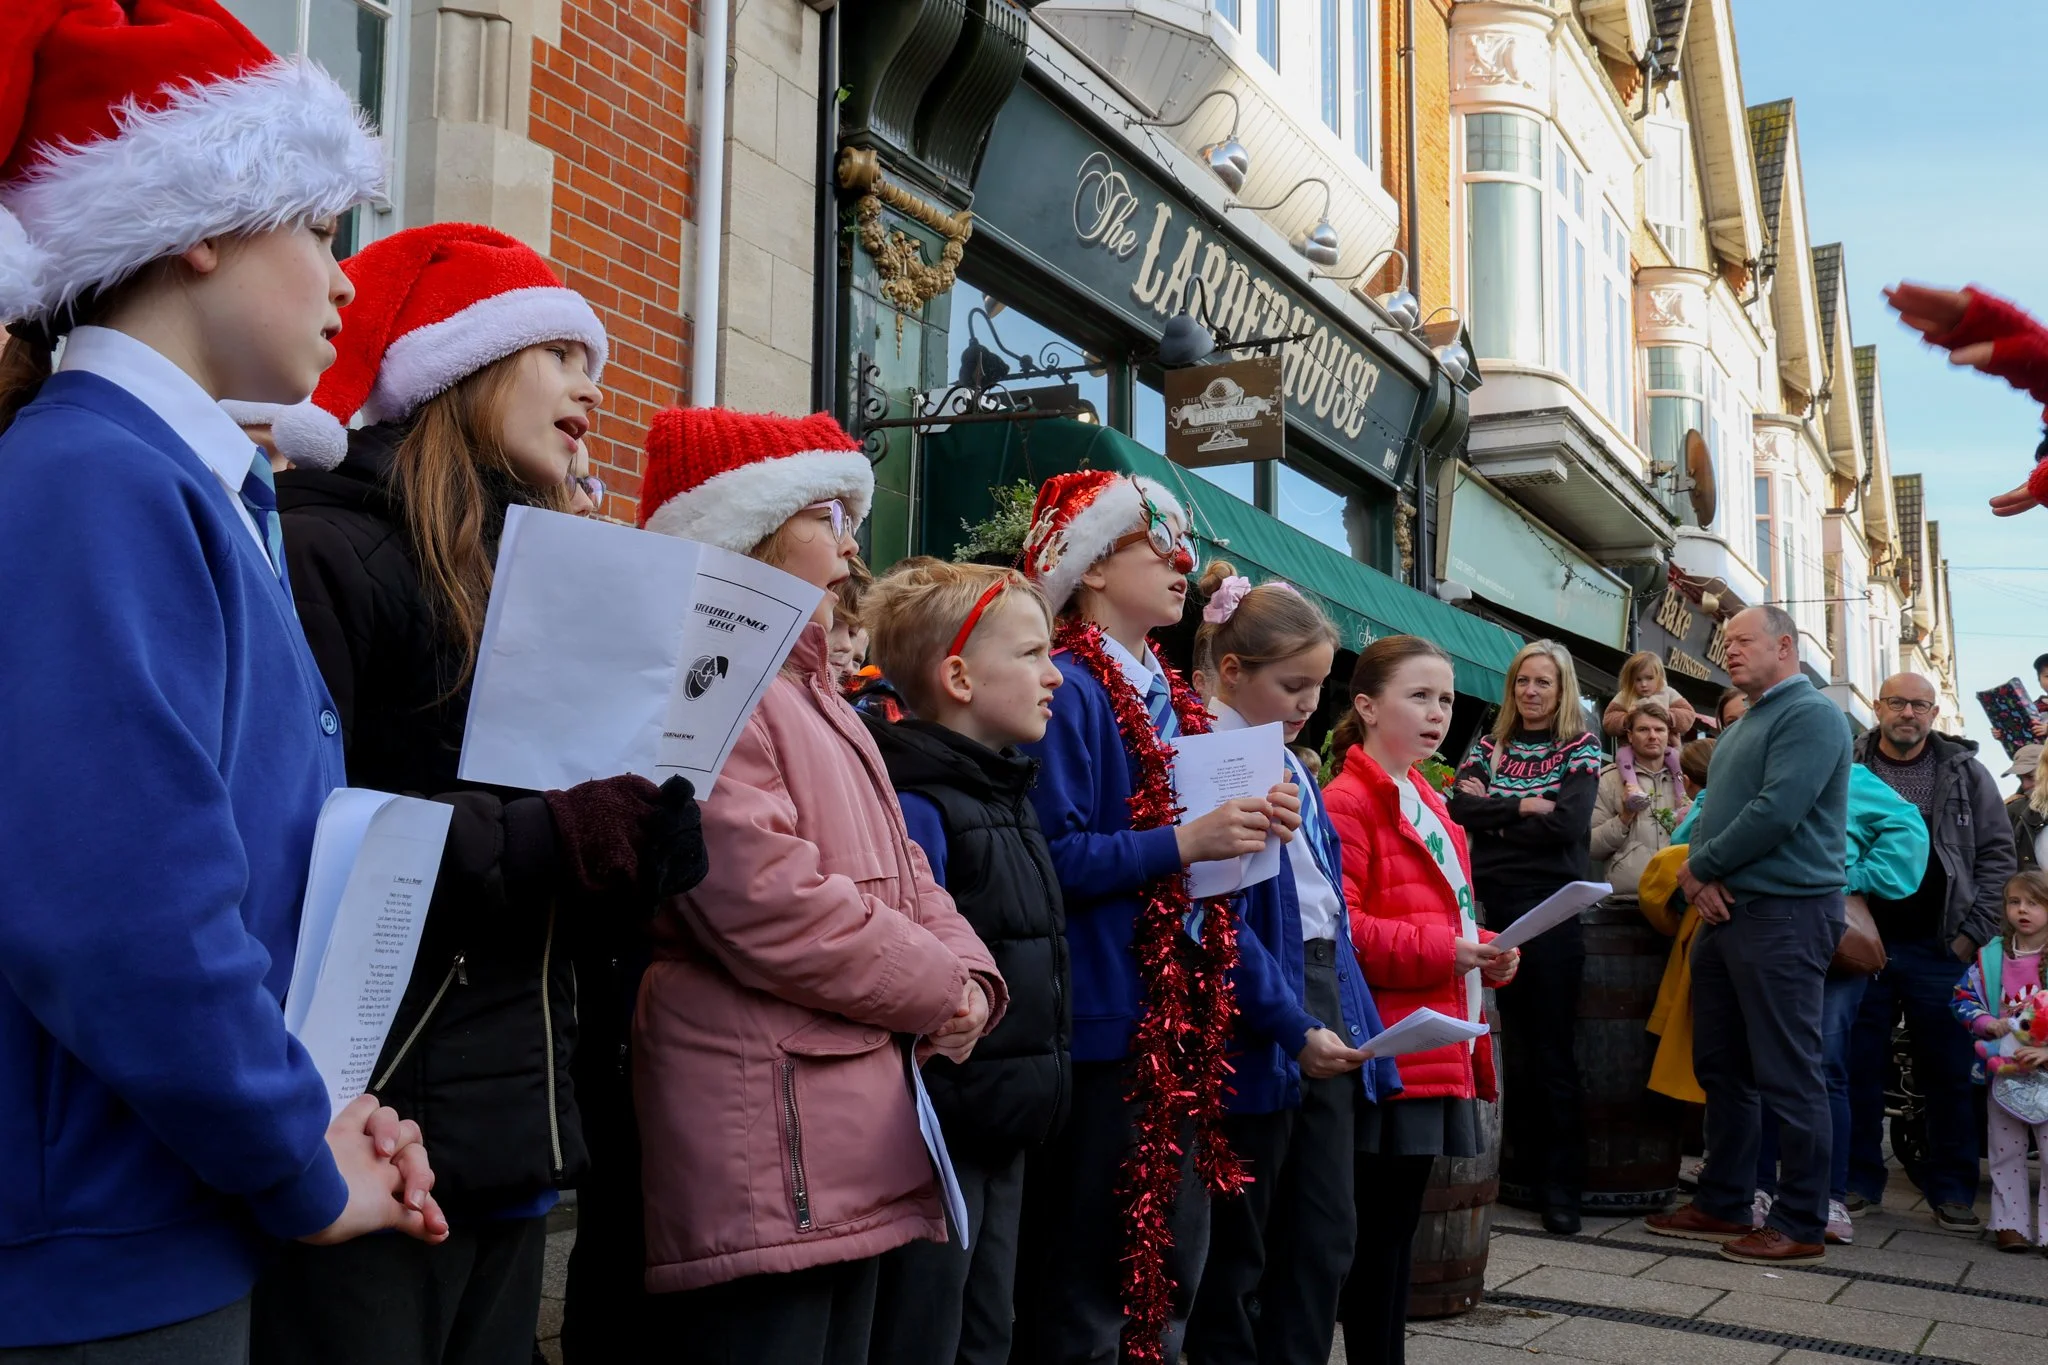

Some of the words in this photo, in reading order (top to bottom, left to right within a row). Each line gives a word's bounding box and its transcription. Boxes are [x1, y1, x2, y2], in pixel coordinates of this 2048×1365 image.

[1073, 151, 1139, 257] The
[1181, 396, 1200, 405] THE
[1193, 407, 1253, 425] LIBRARY
[1656, 586, 1692, 641] Bake
[707, 618, 736, 633] SCHOOL
[734, 614, 770, 632] JUNIOR
